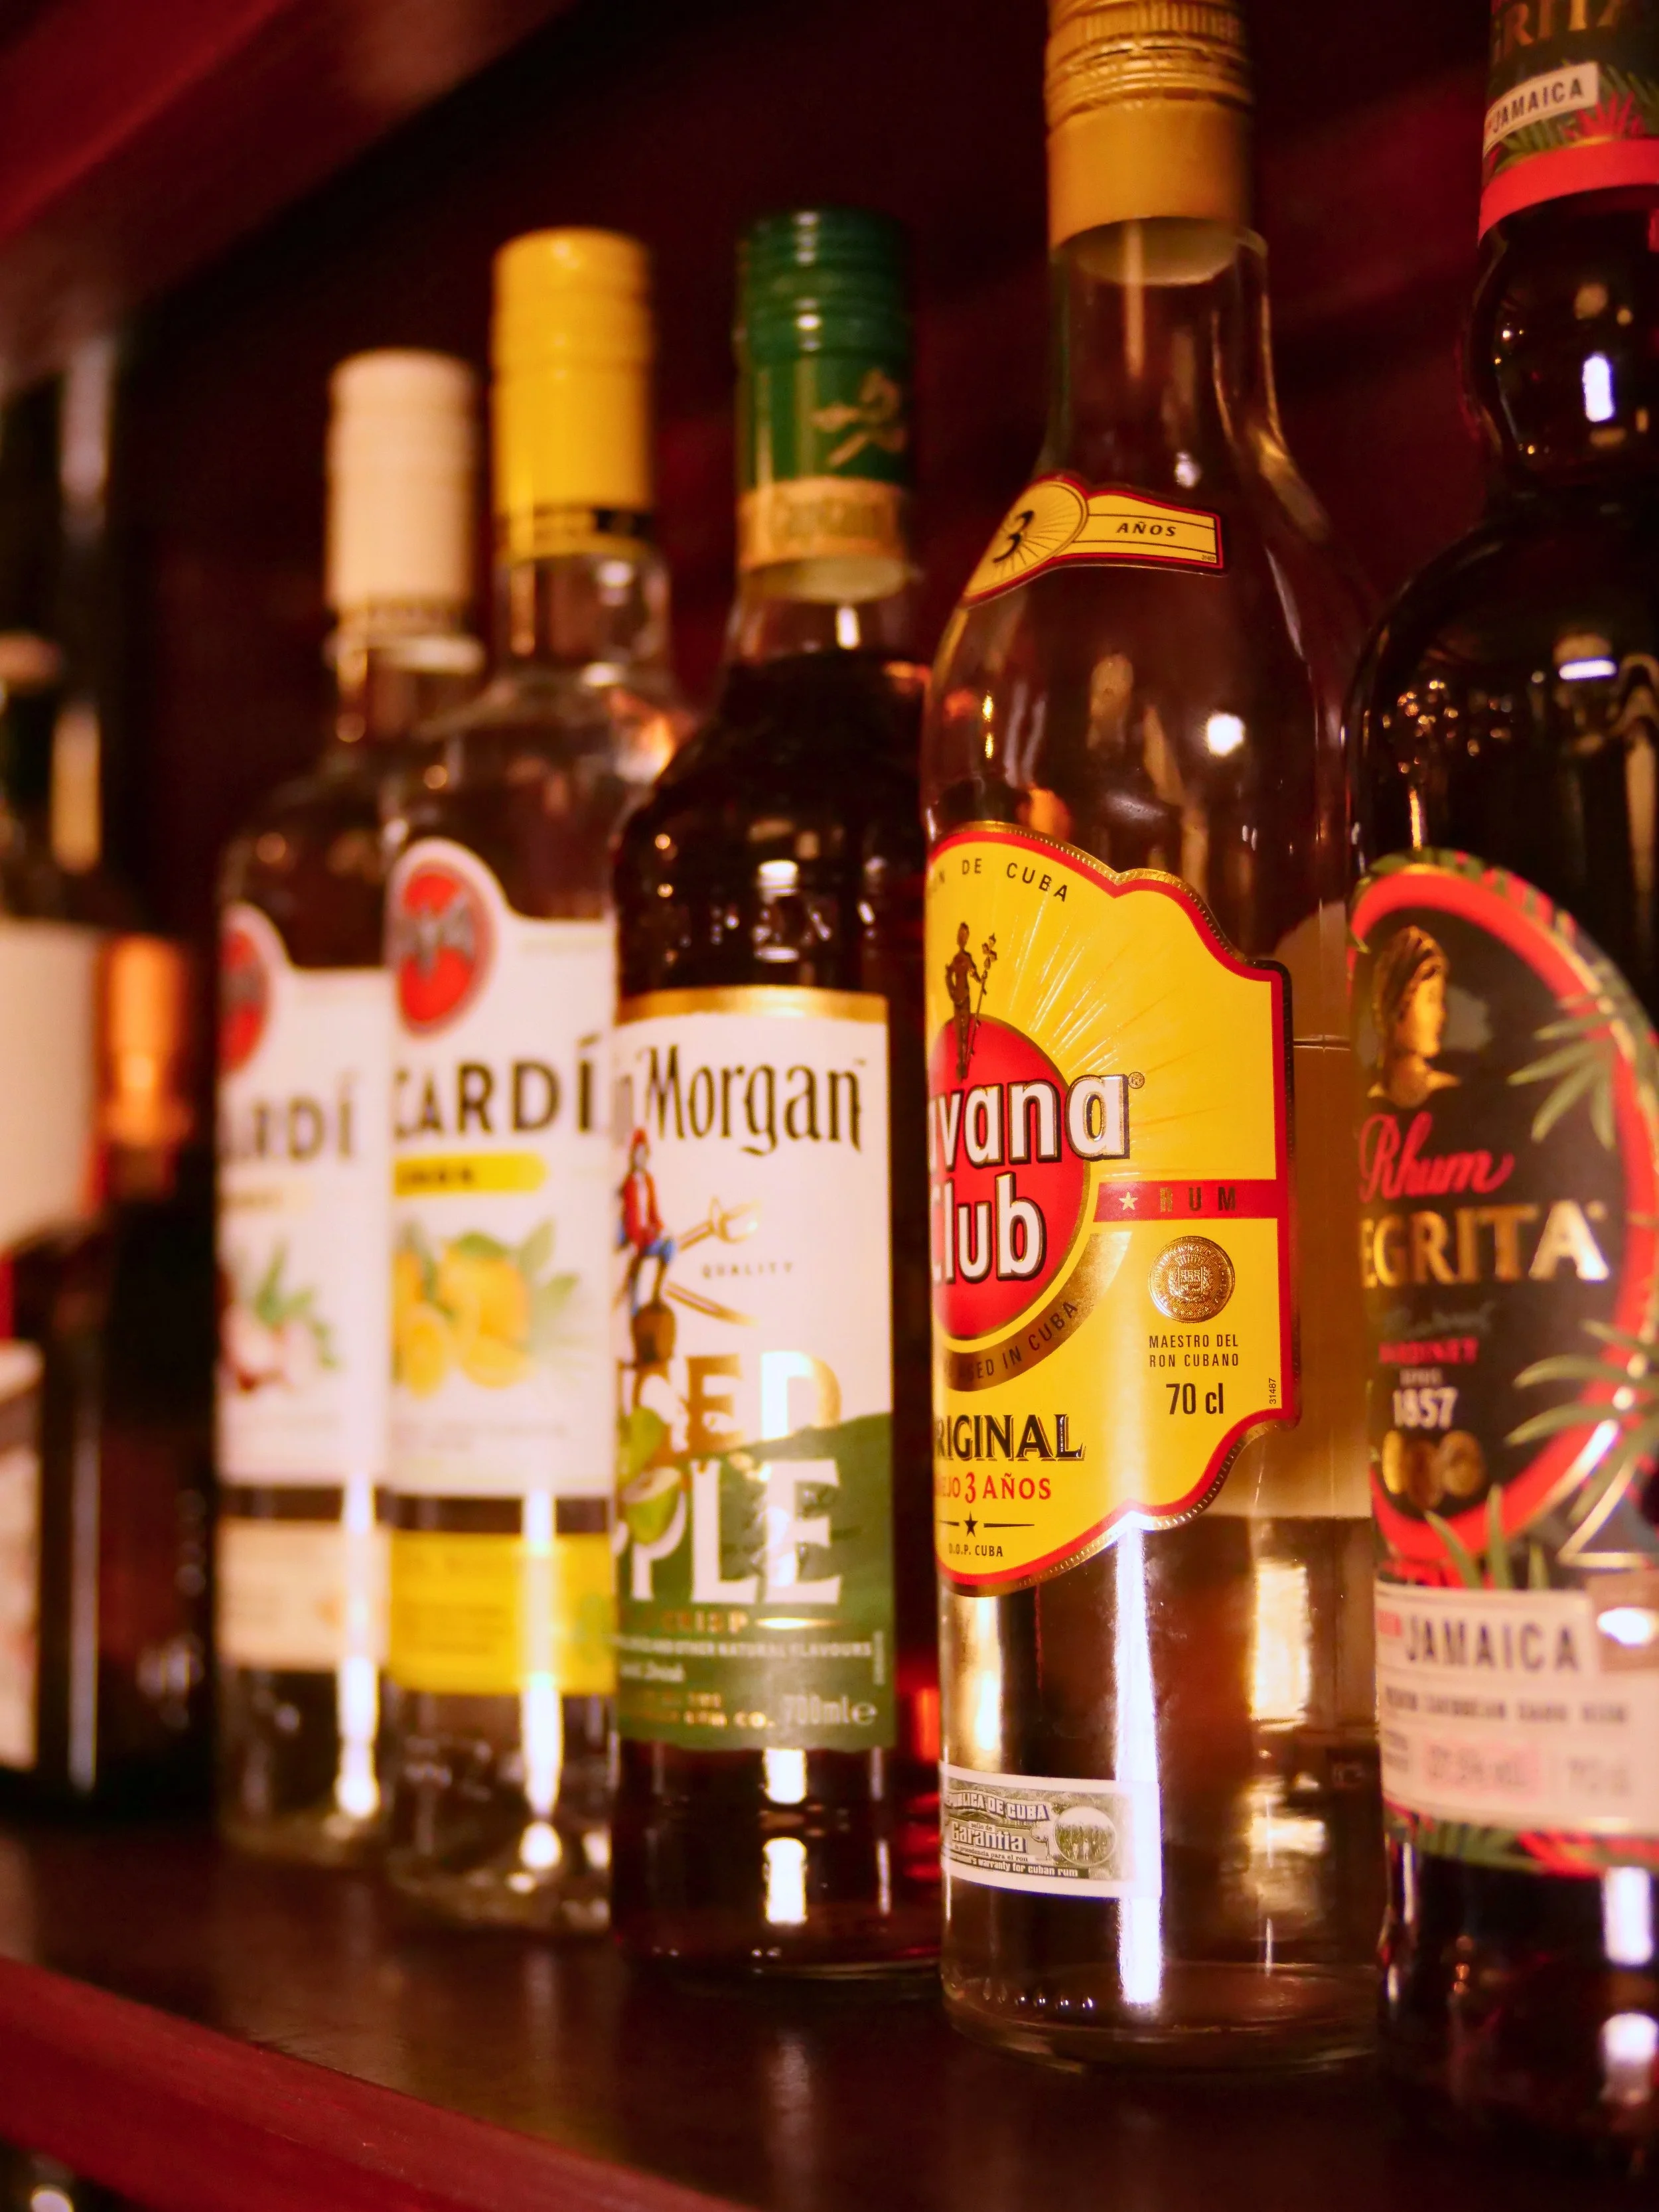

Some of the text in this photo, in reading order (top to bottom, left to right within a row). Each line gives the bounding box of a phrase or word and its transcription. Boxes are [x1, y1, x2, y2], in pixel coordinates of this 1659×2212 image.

[1492, 78, 1584, 133] JAMAICA
[993, 510, 1035, 563] 3
[1116, 522, 1177, 538] AÑOS
[962, 858, 1068, 902] DE CUBA
[637, 1043, 861, 1156] Morgan
[1359, 1110, 1515, 1203] Rhum
[1159, 1187, 1236, 1213] RUM
[1001, 1345, 1023, 1369] IN
[1029, 1301, 1078, 1351] CUBA
[1149, 1334, 1239, 1349] MAESTRO DEL
[1149, 1353, 1239, 1368] RON CUBANO
[1166, 1382, 1224, 1415] 70 cl
[1268, 1377, 1277, 1405] 31487
[965, 1471, 976, 1504] 3
[982, 1472, 1052, 1500] AÑOS
[975, 1544, 1004, 1557] CUBA
[1406, 1615, 1579, 1672] JAMAICA
[987, 1796, 1005, 1816] DE
[1006, 1802, 1050, 1821] CUBA
[978, 1859, 1011, 1872] warranty
[1012, 1863, 1026, 1873] for
[1027, 1865, 1056, 1876] cuban
[1057, 1868, 1079, 1878] rum
